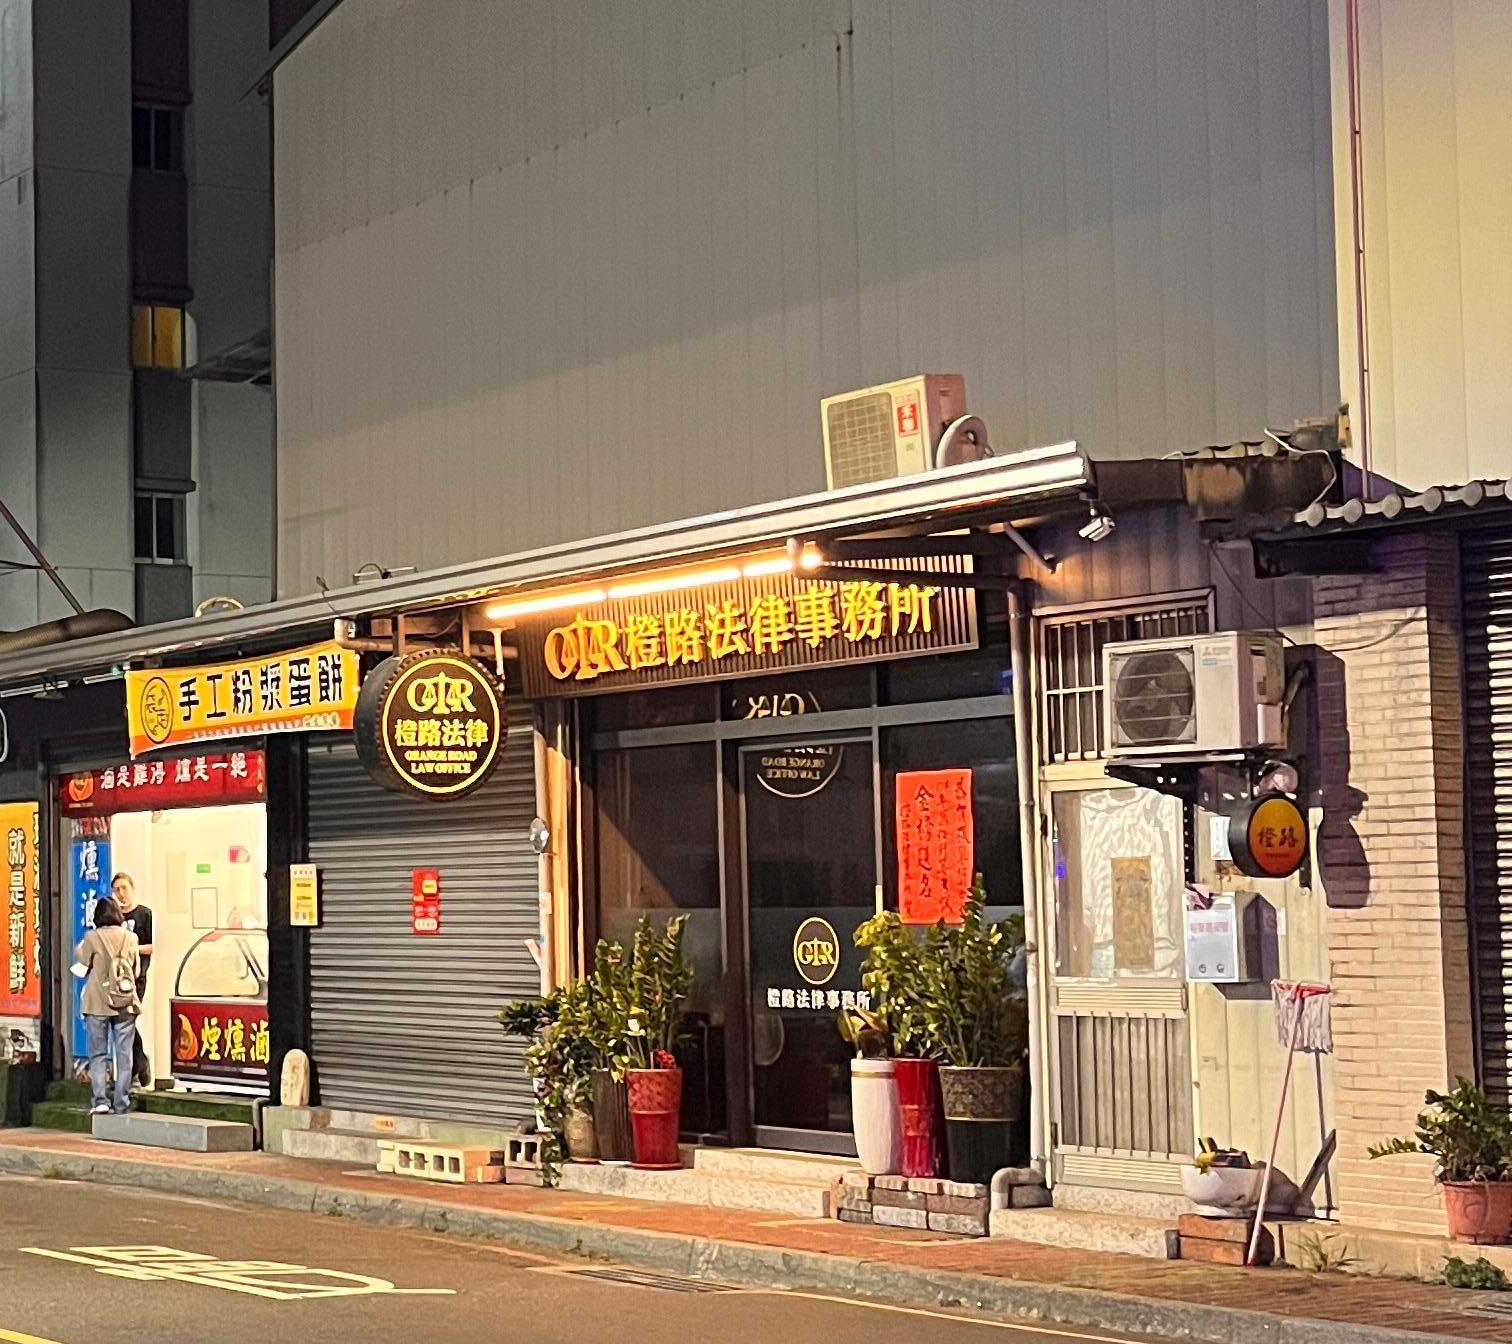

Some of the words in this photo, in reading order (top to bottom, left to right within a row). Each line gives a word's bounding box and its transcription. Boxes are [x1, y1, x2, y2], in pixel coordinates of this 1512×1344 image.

[625, 582, 937, 669] 橙路法律事務所
[178, 654, 343, 722] 手工粉漿蛋餅
[395, 718, 489, 748] 橙路法律
[411, 763, 434, 774] LAW
